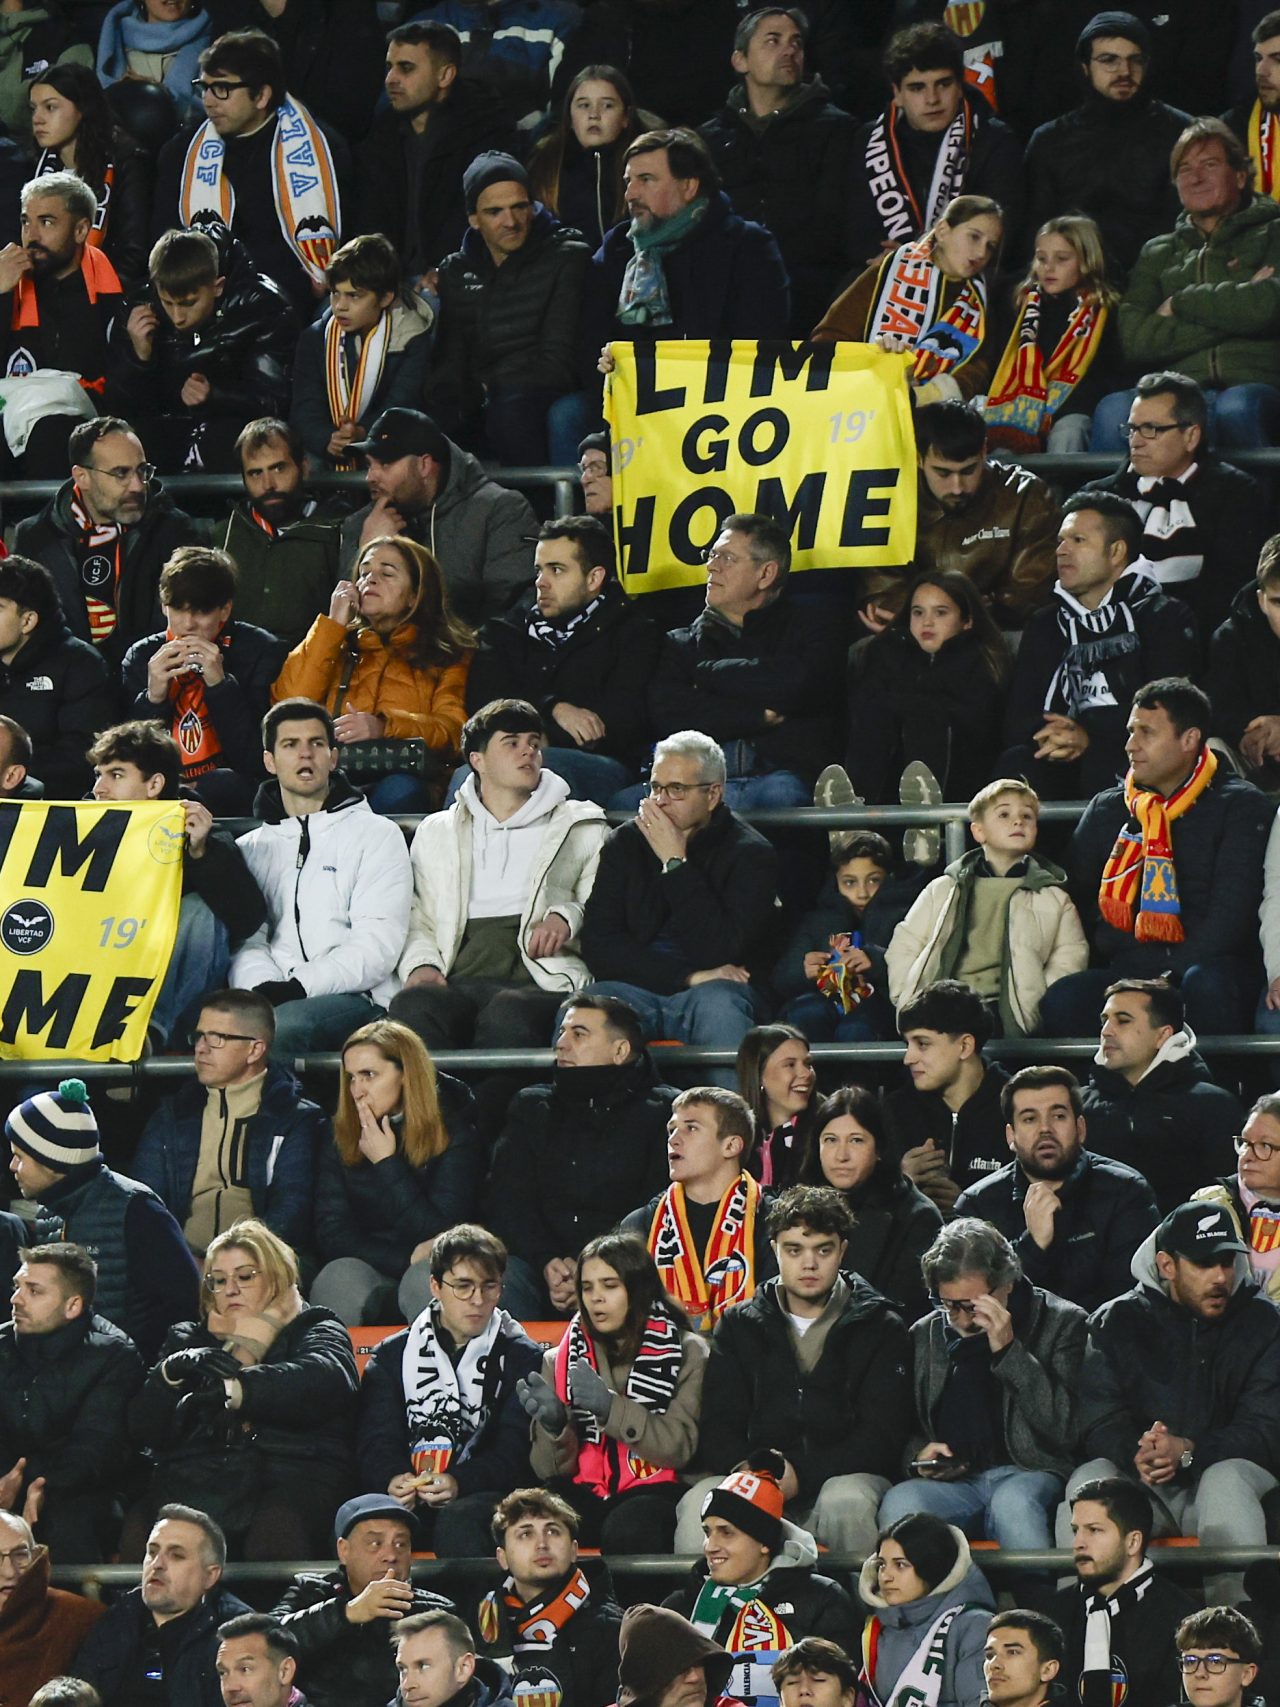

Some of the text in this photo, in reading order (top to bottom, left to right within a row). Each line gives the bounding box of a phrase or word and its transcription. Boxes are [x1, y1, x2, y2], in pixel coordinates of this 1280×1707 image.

[865, 117, 913, 241] MPEÓN
[633, 339, 837, 416] LIM
[681, 407, 790, 475] GO
[829, 409, 876, 444] 19'
[616, 468, 900, 575] HOME
[8, 928, 44, 938] LIBERTAD
[18, 937, 32, 945] VCF
[98, 916, 148, 948] 19'
